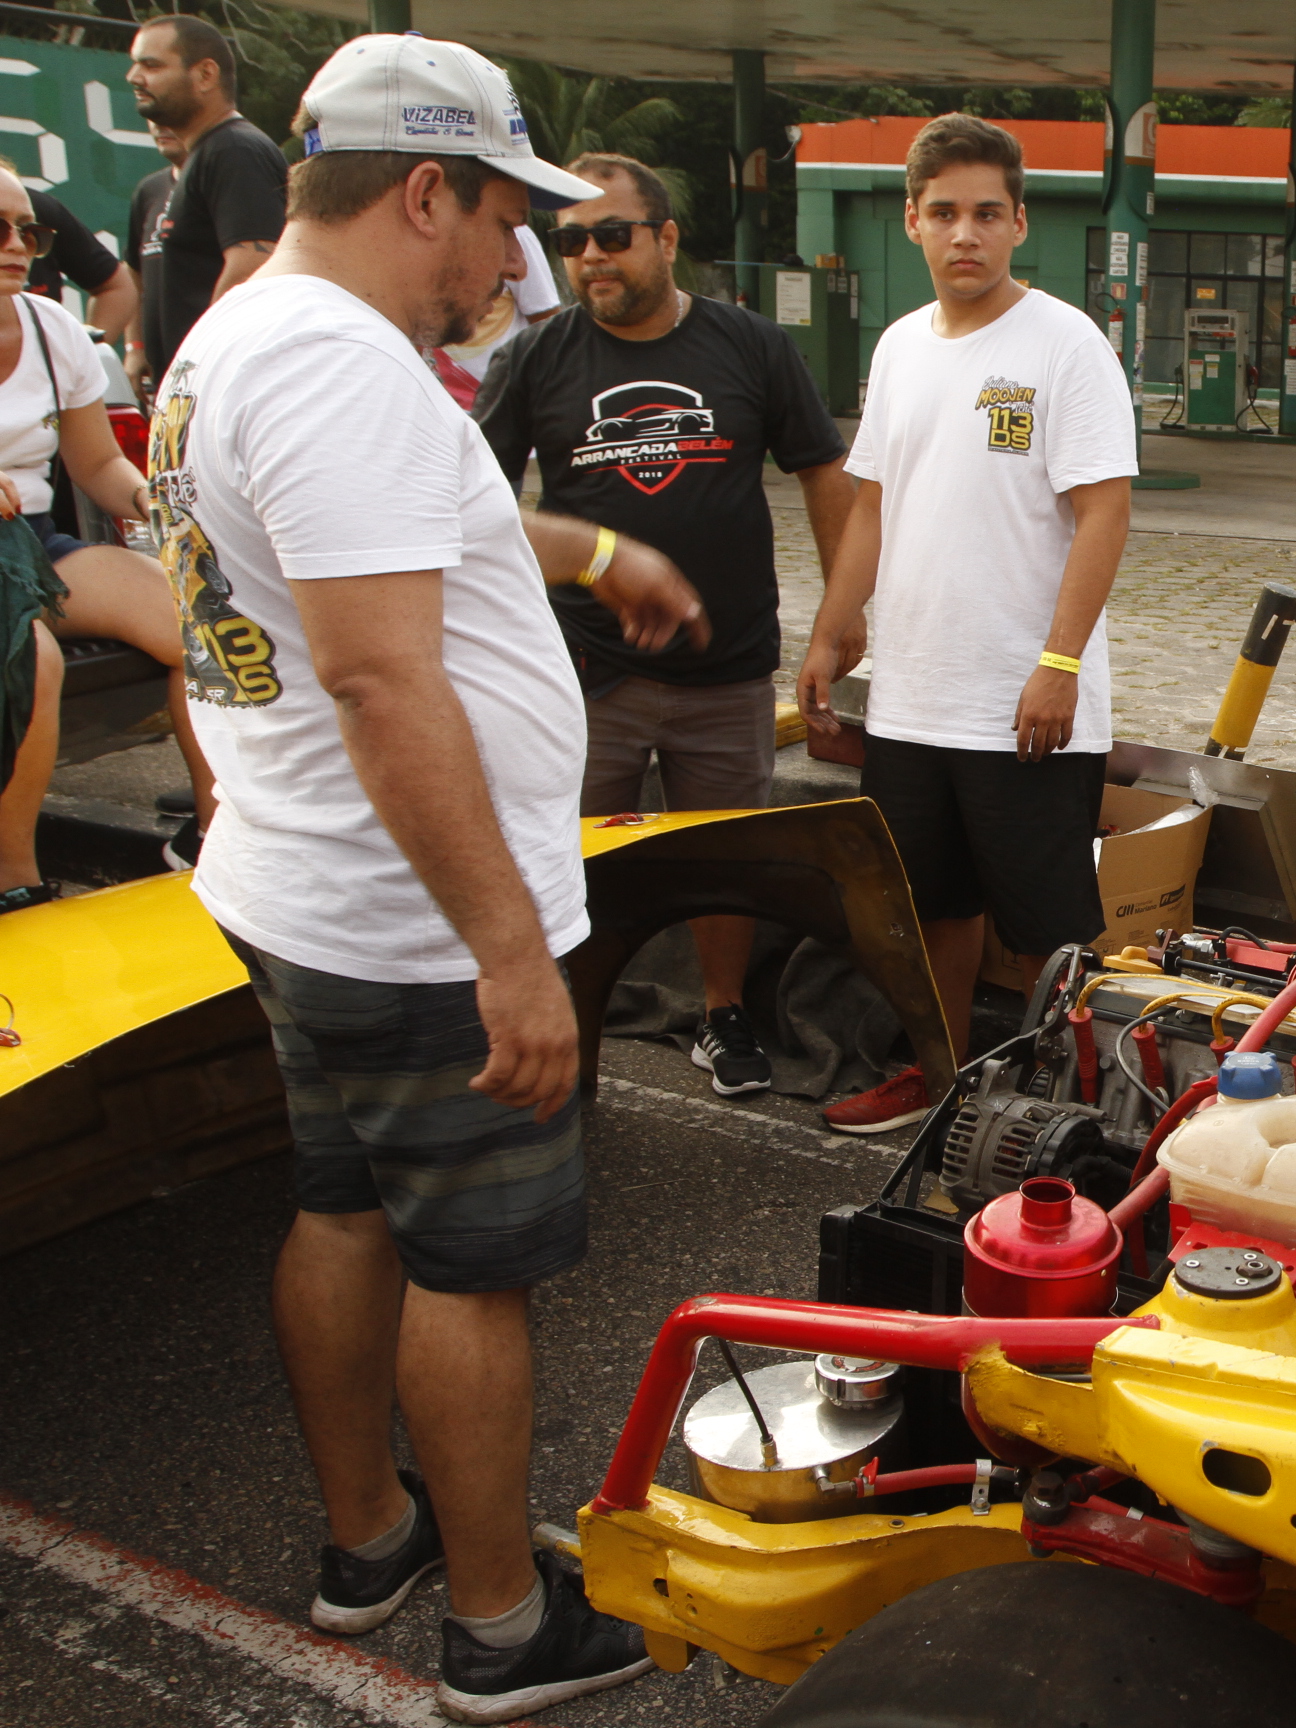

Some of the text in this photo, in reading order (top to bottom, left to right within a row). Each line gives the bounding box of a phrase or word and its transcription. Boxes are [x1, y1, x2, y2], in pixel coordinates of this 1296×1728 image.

[975, 387, 1036, 410] MOOJEN
[988, 405, 1033, 434] 113
[989, 428, 1031, 451] DS
[620, 454, 681, 464] FESTIVAL
